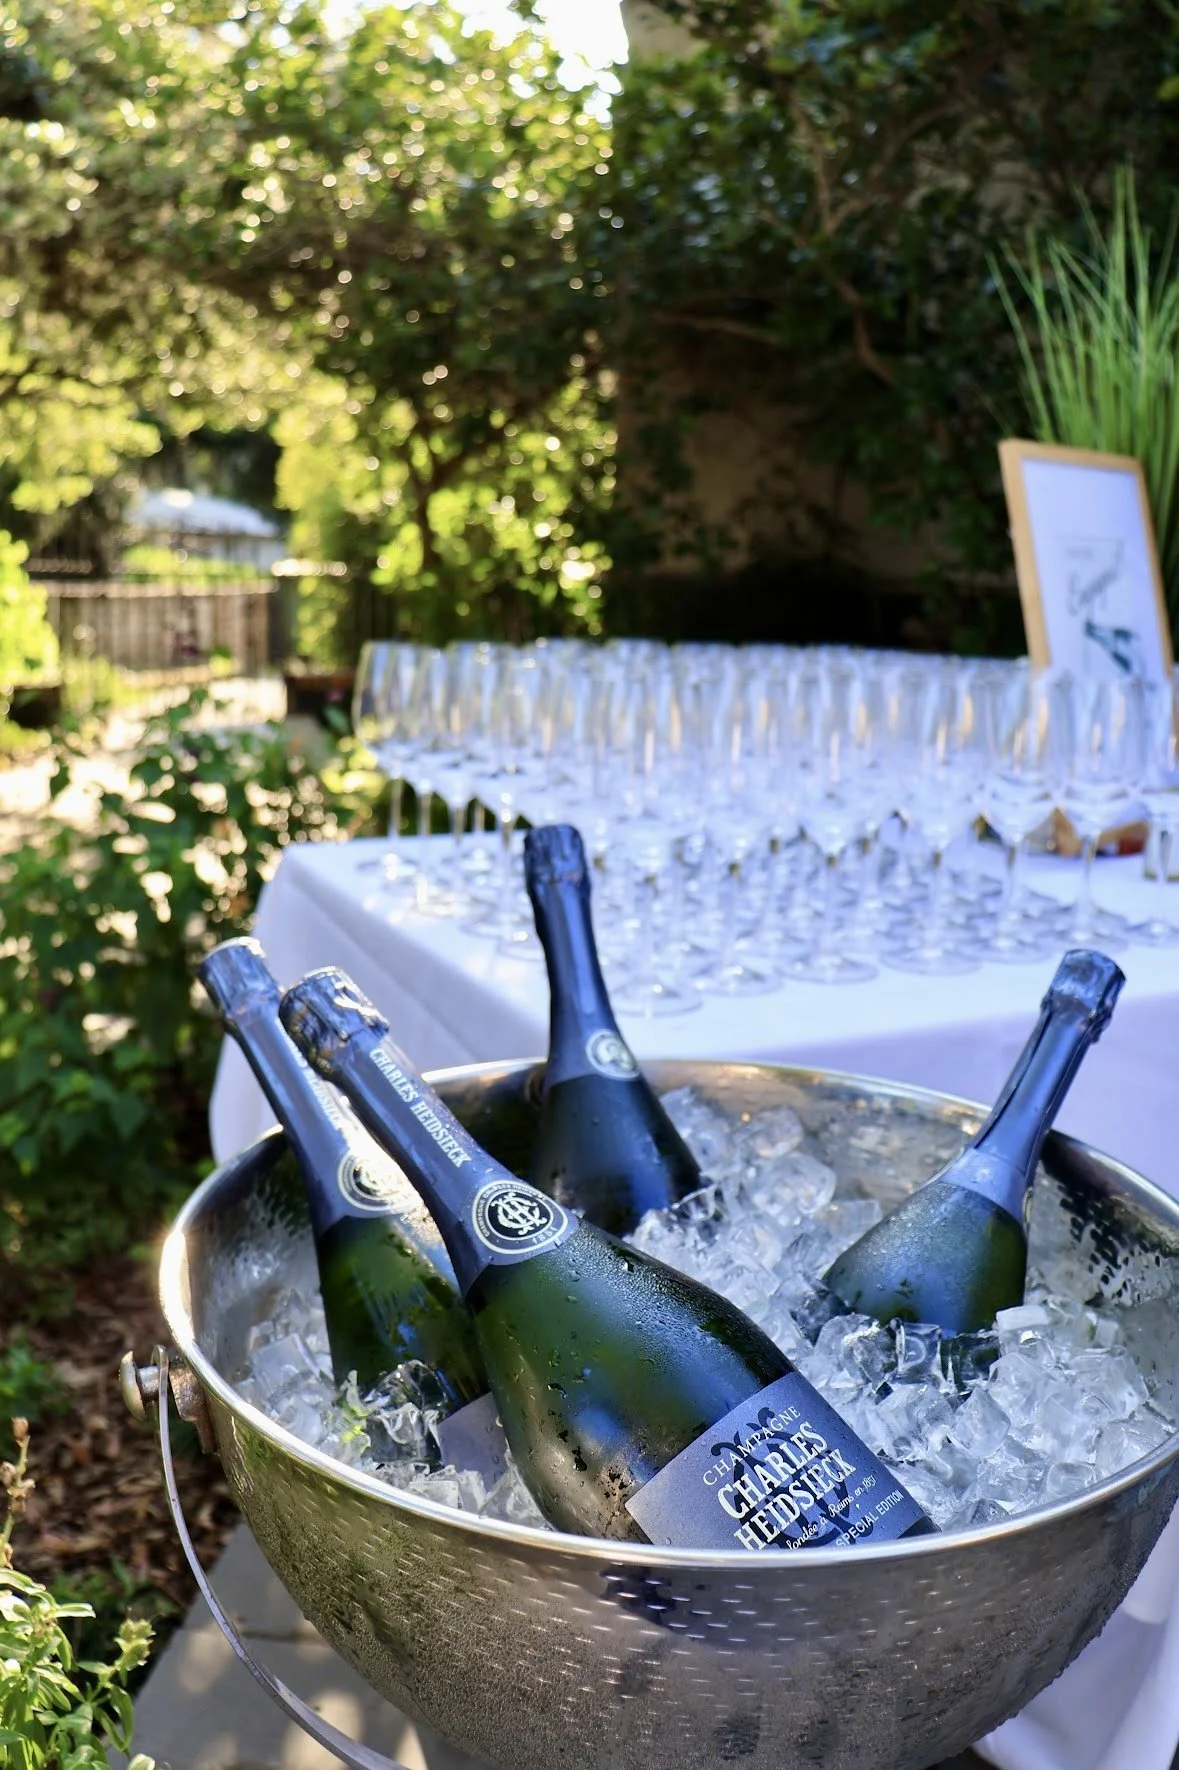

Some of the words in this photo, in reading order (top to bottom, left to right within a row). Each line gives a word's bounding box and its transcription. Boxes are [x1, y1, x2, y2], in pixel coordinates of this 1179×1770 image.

[369, 1047, 419, 1103] CHARLES
[409, 1100, 472, 1168] HEIDSIECK
[532, 1225, 558, 1244] 1851
[703, 1406, 801, 1486] CHAMPAGNE
[717, 1421, 828, 1519] CHARLES
[733, 1448, 857, 1550] HEIDSIECK
[819, 1515, 828, 1526] à
[828, 1495, 855, 1518] Reims
[854, 1486, 864, 1496] en
[835, 1511, 880, 1548] SPECIAL
[875, 1489, 905, 1516] EDITION
